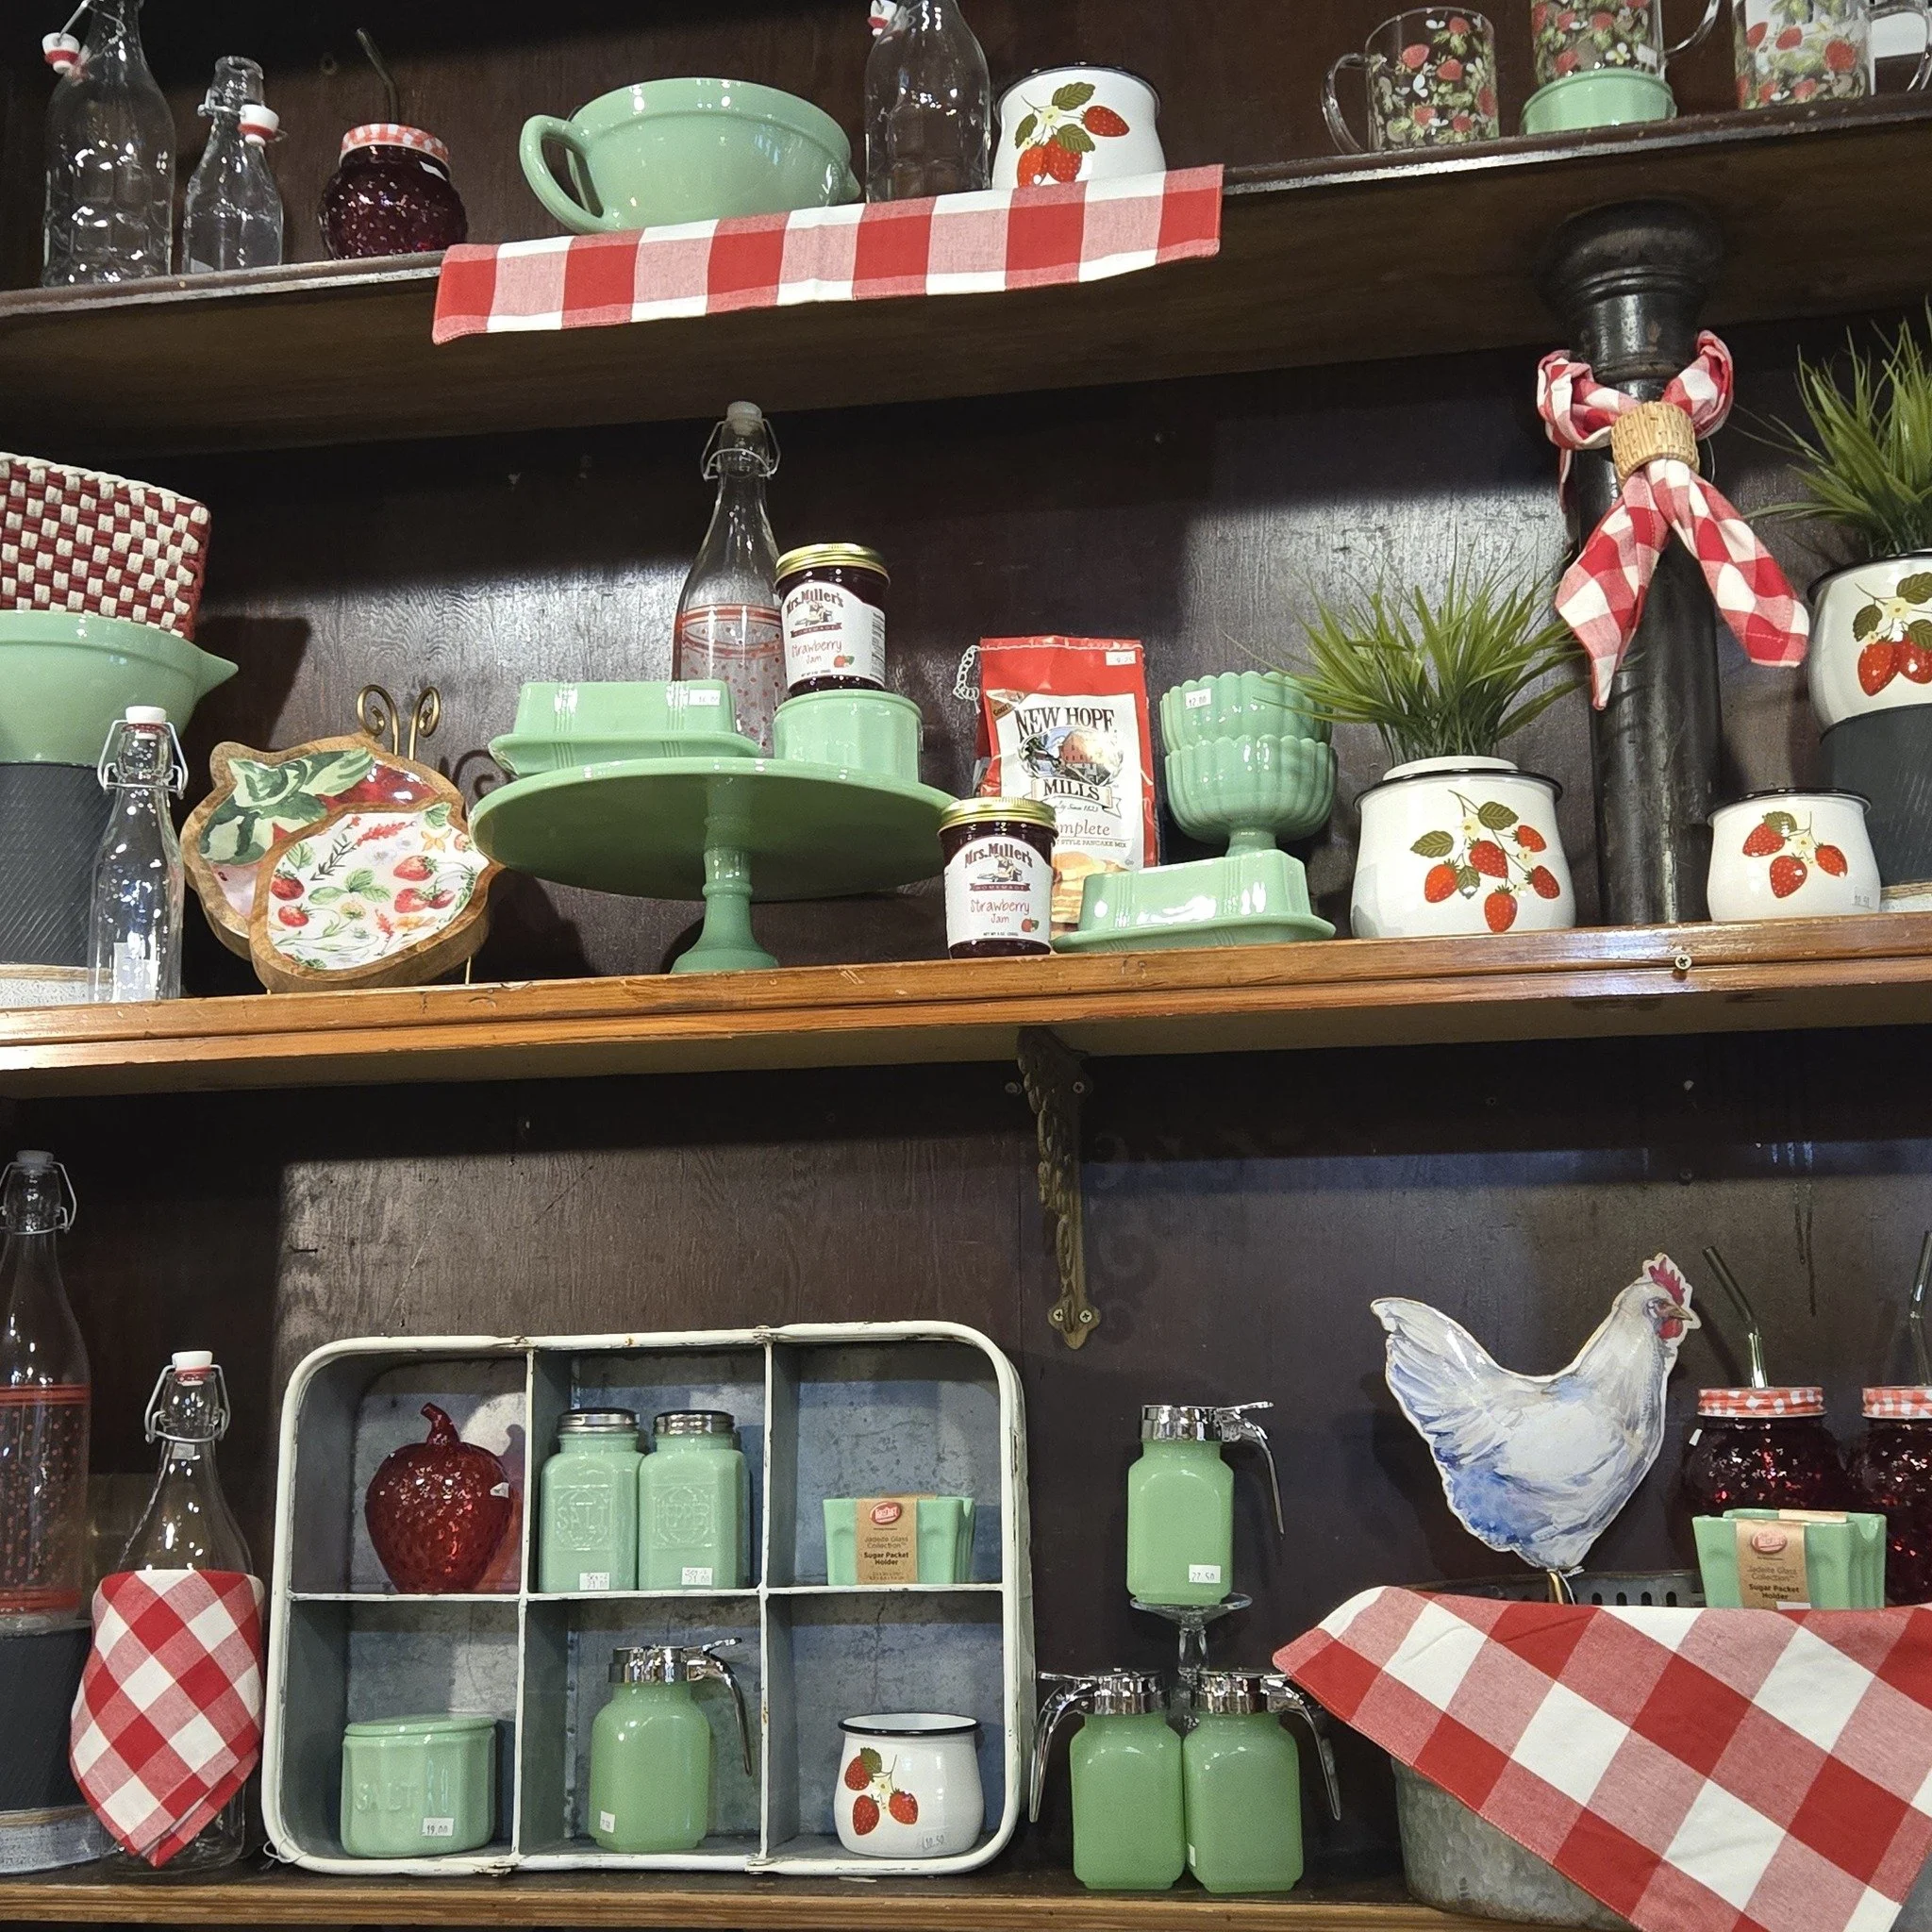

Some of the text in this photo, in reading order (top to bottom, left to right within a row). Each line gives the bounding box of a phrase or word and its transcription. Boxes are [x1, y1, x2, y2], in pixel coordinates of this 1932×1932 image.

[801, 589, 843, 608] Miller's
[791, 640, 842, 658] Strawberry
[806, 654, 823, 664] Jam
[1015, 707, 1060, 743] NEW
[1064, 707, 1115, 733] HOPE
[1043, 778, 1100, 801] MILLS
[1057, 819, 1110, 837] mplete
[965, 842, 1033, 868] Mrs. Miller's
[970, 898, 1030, 916] Strawberry
[991, 913, 1009, 924] Jam
[864, 1551, 884, 1559] Sugar
[1748, 1584, 1799, 1593] Sugar Packet
[426, 1824, 448, 1836] 19.00
